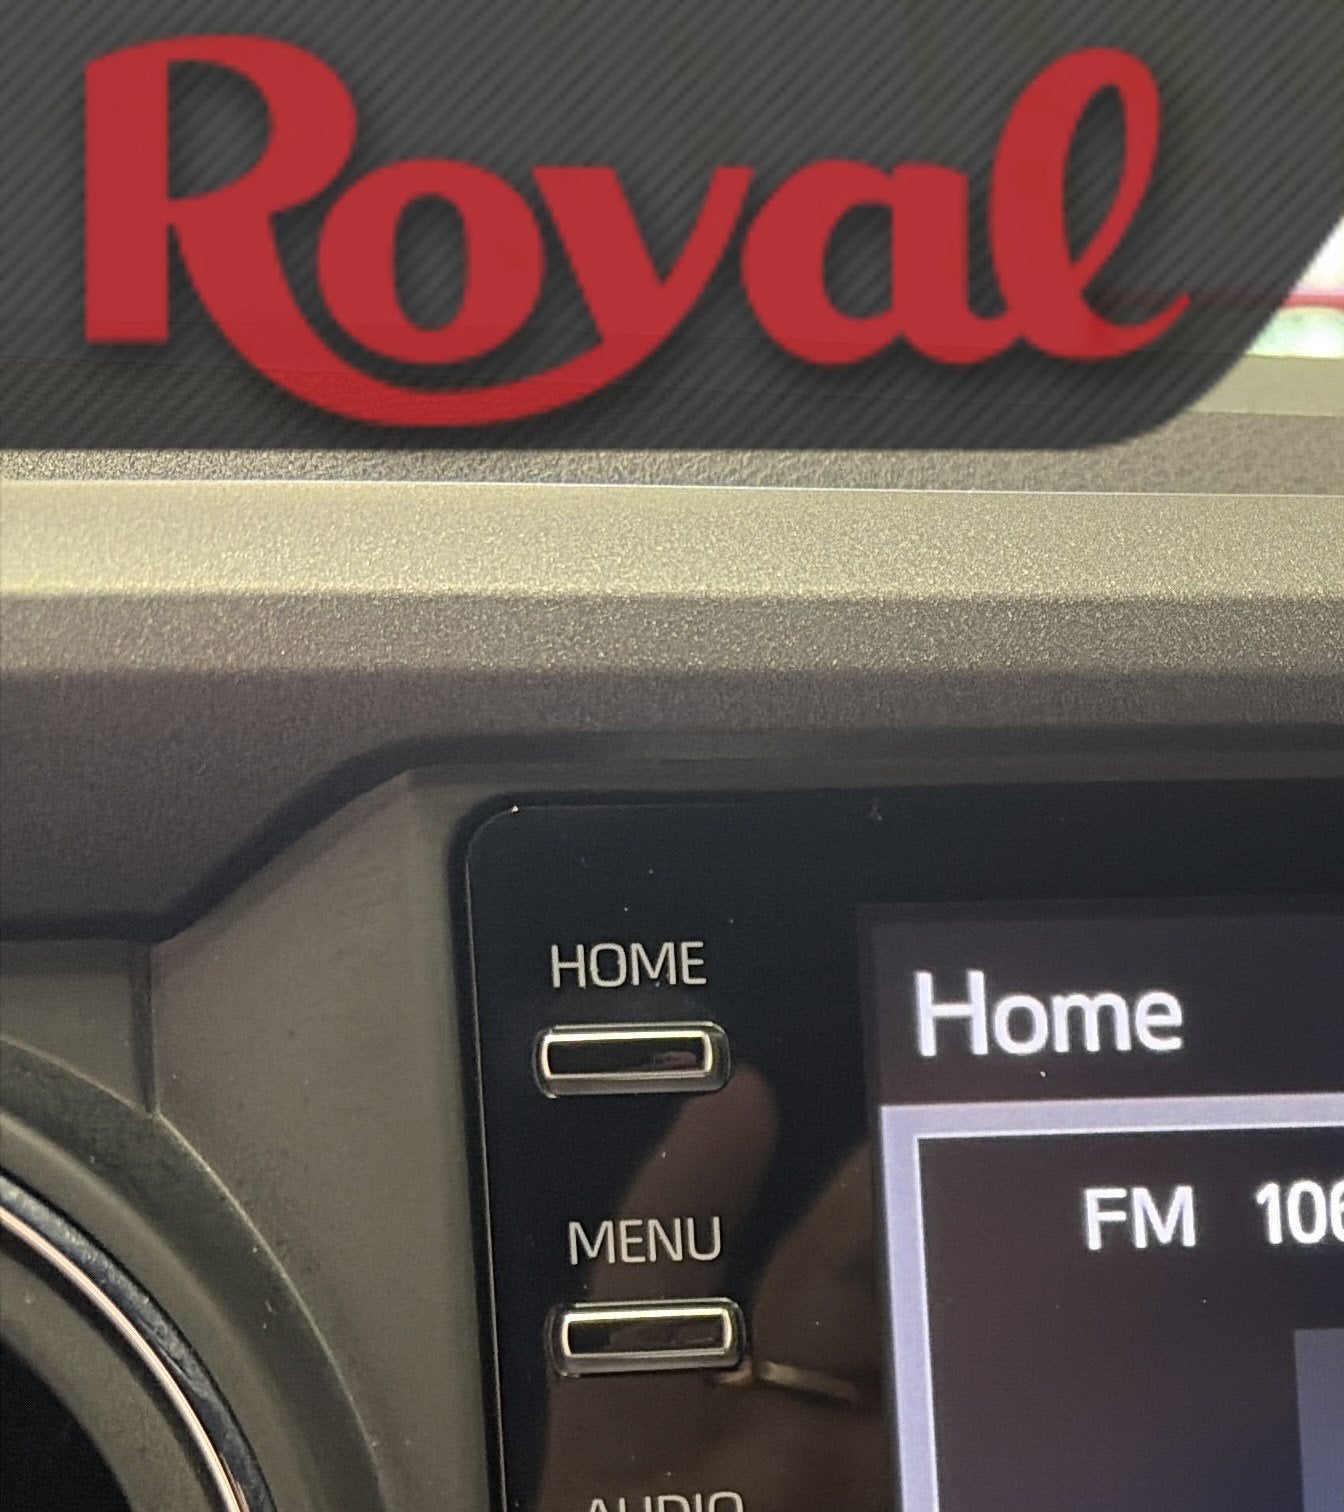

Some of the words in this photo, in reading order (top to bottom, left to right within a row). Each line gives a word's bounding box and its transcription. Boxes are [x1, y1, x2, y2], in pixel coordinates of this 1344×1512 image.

[550, 940, 707, 989] HOME
[914, 970, 1184, 1057] Home
[567, 1216, 722, 1265] MENU
[1082, 1185, 1197, 1250] FM
